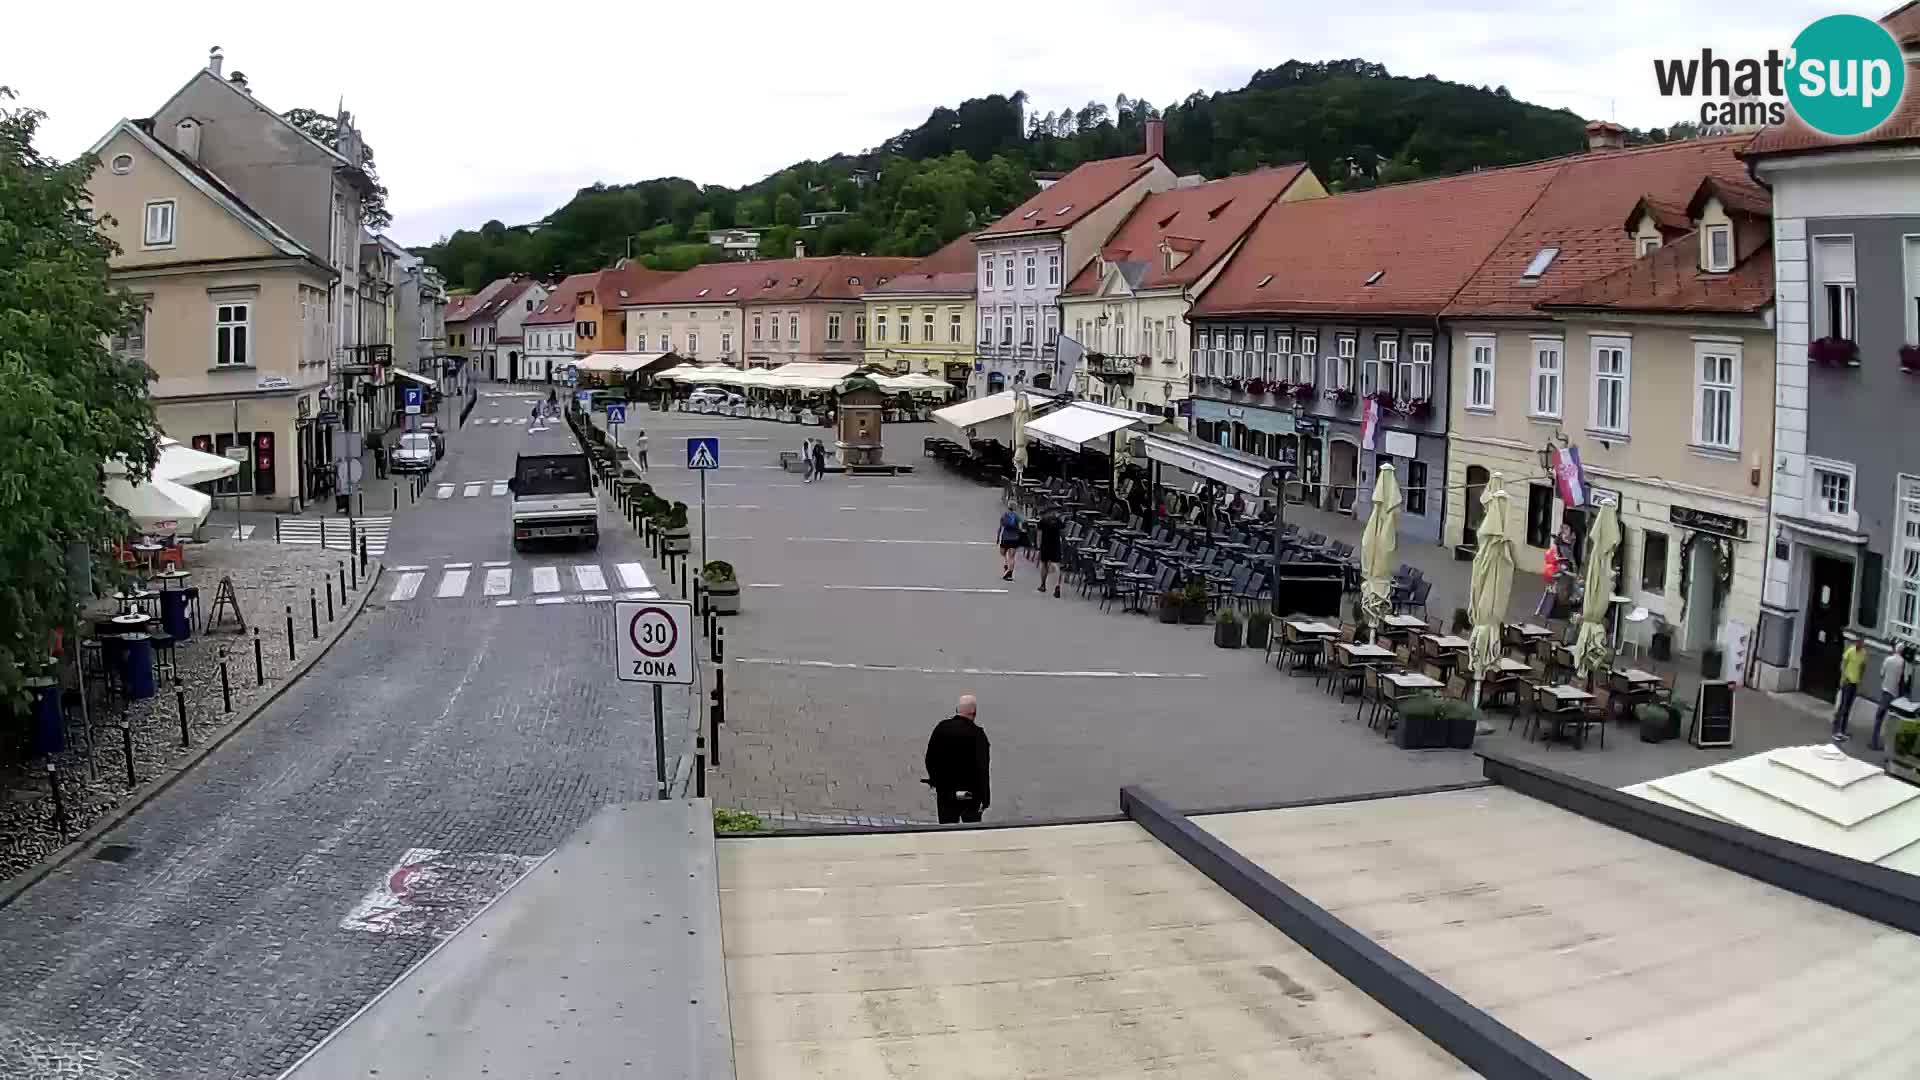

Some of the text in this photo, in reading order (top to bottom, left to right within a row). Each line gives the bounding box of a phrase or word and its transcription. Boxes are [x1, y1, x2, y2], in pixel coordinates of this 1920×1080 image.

[408, 391, 417, 403] P
[641, 623, 666, 644] 30
[633, 660, 677, 677] ZONA
